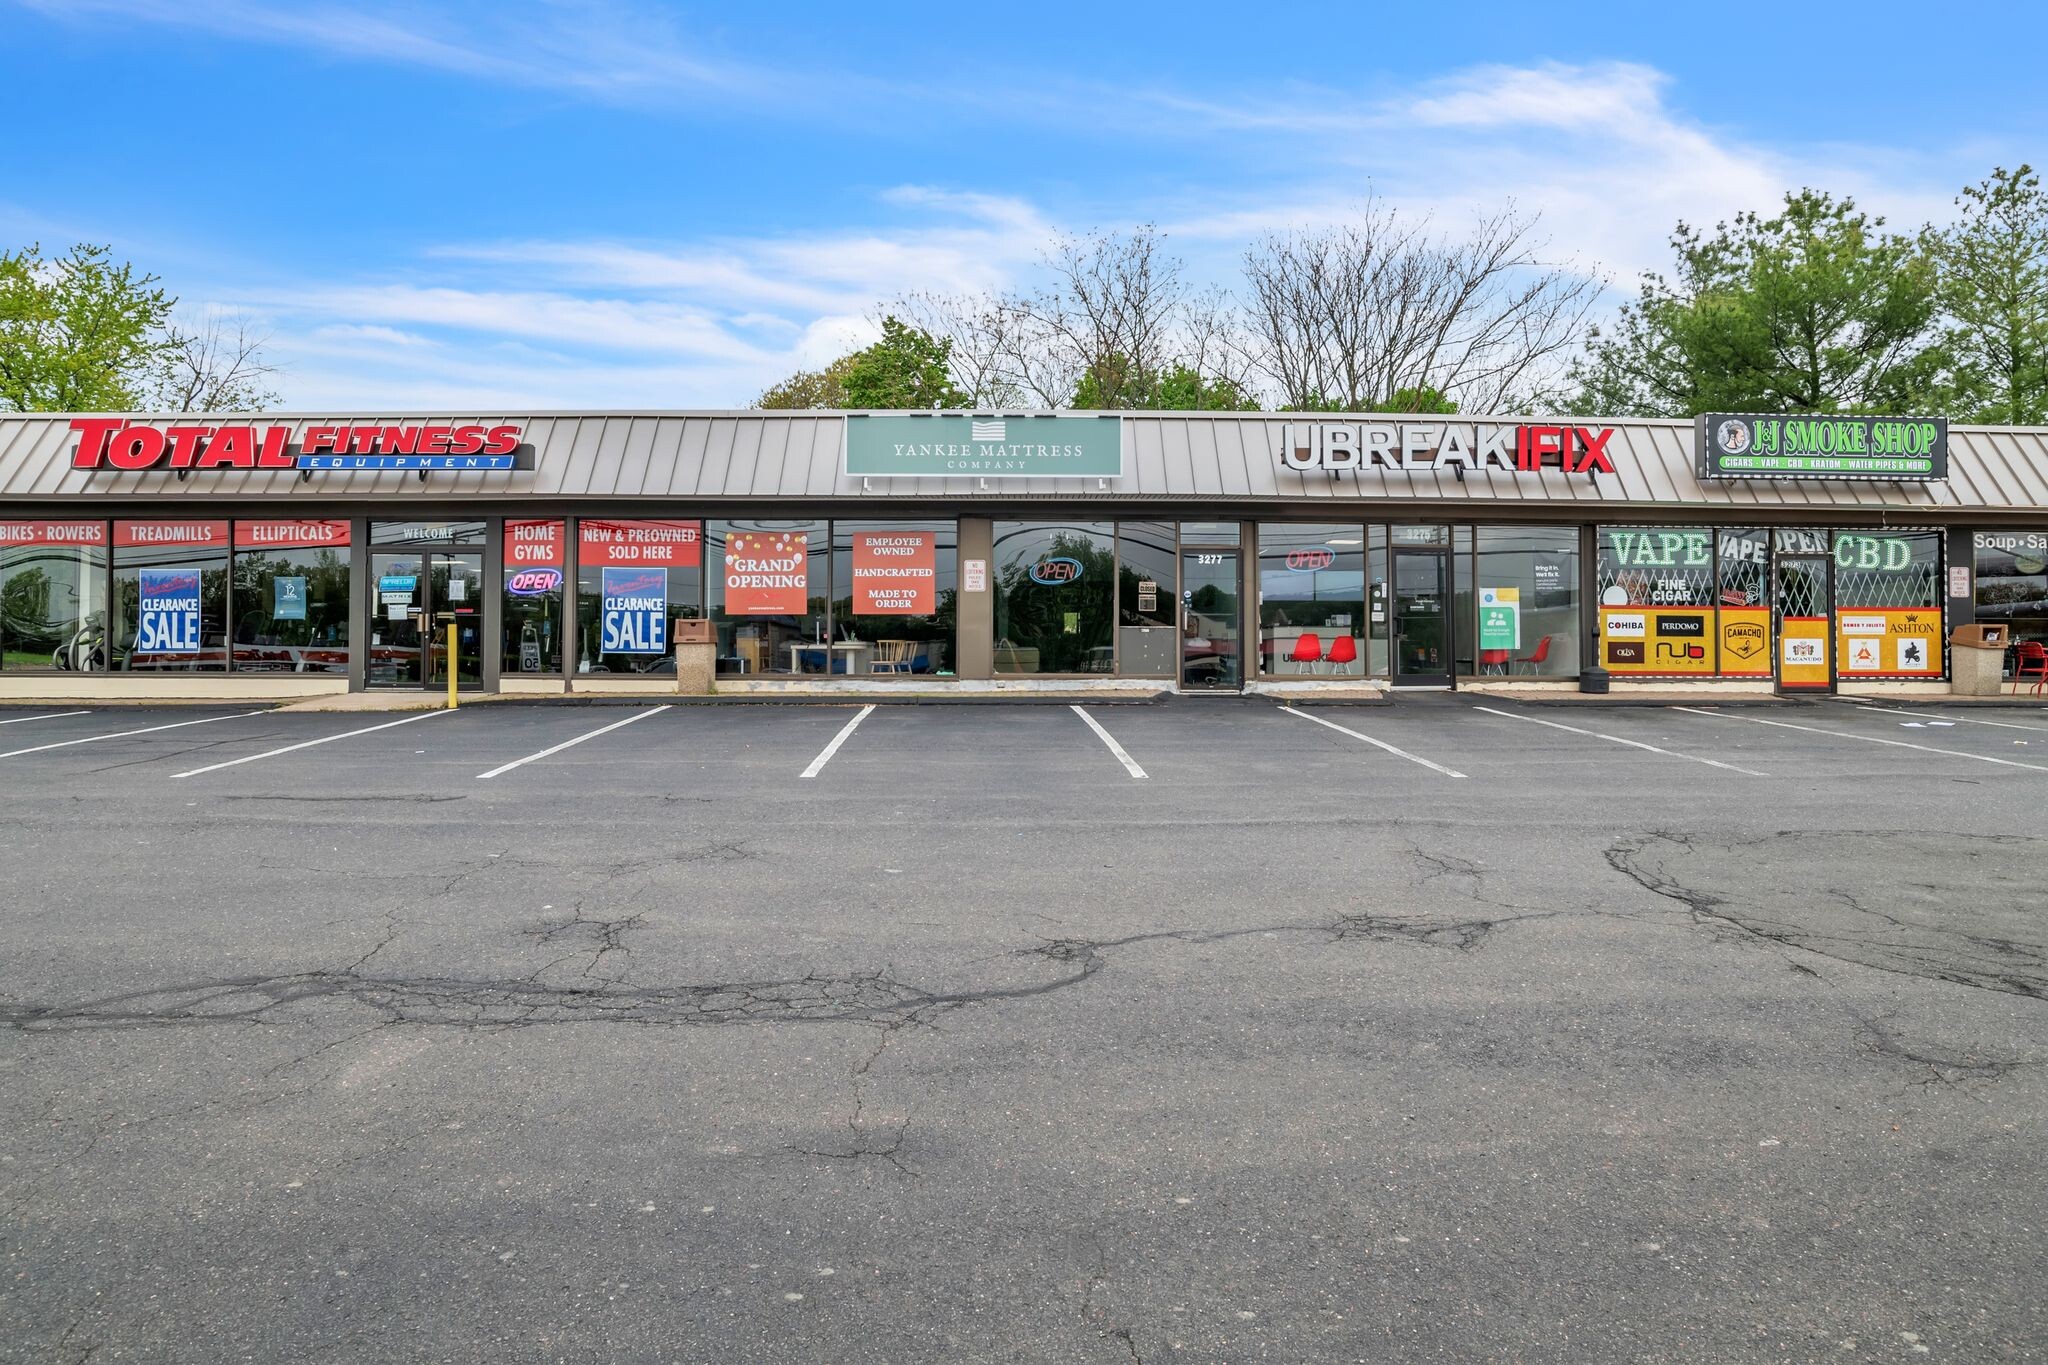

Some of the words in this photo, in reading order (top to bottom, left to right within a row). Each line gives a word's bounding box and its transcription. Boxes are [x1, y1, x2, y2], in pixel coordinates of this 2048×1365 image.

[69, 418, 297, 469] TOTAL
[300, 425, 521, 455] FITNESS
[1751, 420, 1781, 455] J&J
[1784, 420, 1868, 456] SMOKE
[1872, 422, 1937, 457] SHOP
[893, 444, 971, 456] YANKEE
[981, 445, 1083, 457] MATTRESS
[1282, 424, 1616, 473] UBREAKIFIX
[310, 458, 500, 467] EQUIPMENT
[947, 461, 1026, 469] COMPANY
[1725, 459, 1753, 468] CIGARS
[1761, 460, 1779, 468] VAPE
[1788, 460, 1803, 469] CBD
[1811, 461, 1841, 469] KRATOM
[1849, 461, 1873, 470] WATER
[1875, 462, 1897, 470] PIPES
[1899, 462, 1904, 470] &
[1906, 462, 1927, 471] MORE
[0, 526, 35, 541] BIKES
[46, 526, 101, 541] ROWERS
[130, 526, 212, 541] TREADMILLS
[252, 525, 333, 541] ELLIPTICALS
[403, 528, 453, 539] WELCOME
[514, 526, 555, 541] HOME
[583, 530, 612, 542] NEW
[615, 530, 624, 542] &
[628, 529, 696, 542] PREOWNED
[1406, 528, 1430, 541] 3275
[865, 537, 922, 546] EMPLOYEE
[1974, 534, 2016, 551] Soup
[514, 545, 554, 560] GYMS
[608, 546, 639, 559] SOLD
[642, 546, 672, 559] HERE
[873, 547, 914, 556] OWNED
[1609, 532, 1710, 566] VAPE
[1719, 534, 1768, 564] VAPE
[1834, 534, 1911, 571] CBD
[734, 559, 796, 573] GRAND
[1198, 555, 1222, 565] 3277
[1287, 550, 1332, 569] OPEN
[854, 567, 933, 577] HANDCRAFTED
[1035, 562, 1076, 580] OPEN
[512, 573, 555, 590] OPEN
[607, 576, 664, 595] Inventory
[727, 575, 806, 589] OPENING
[1658, 580, 1686, 590] FINE
[868, 589, 900, 598] MADE
[902, 589, 917, 598] TO
[1652, 591, 1691, 601] CIGAR
[142, 598, 198, 611] CLEARANCE
[605, 598, 663, 610] CLEARANCE
[875, 600, 912, 608] ORDER
[142, 612, 198, 649] SALE
[604, 611, 663, 649] SALE
[1608, 621, 1644, 629] COHIBA
[1889, 623, 1935, 633] ASHTON
[1728, 628, 1761, 638] CAMACHO
